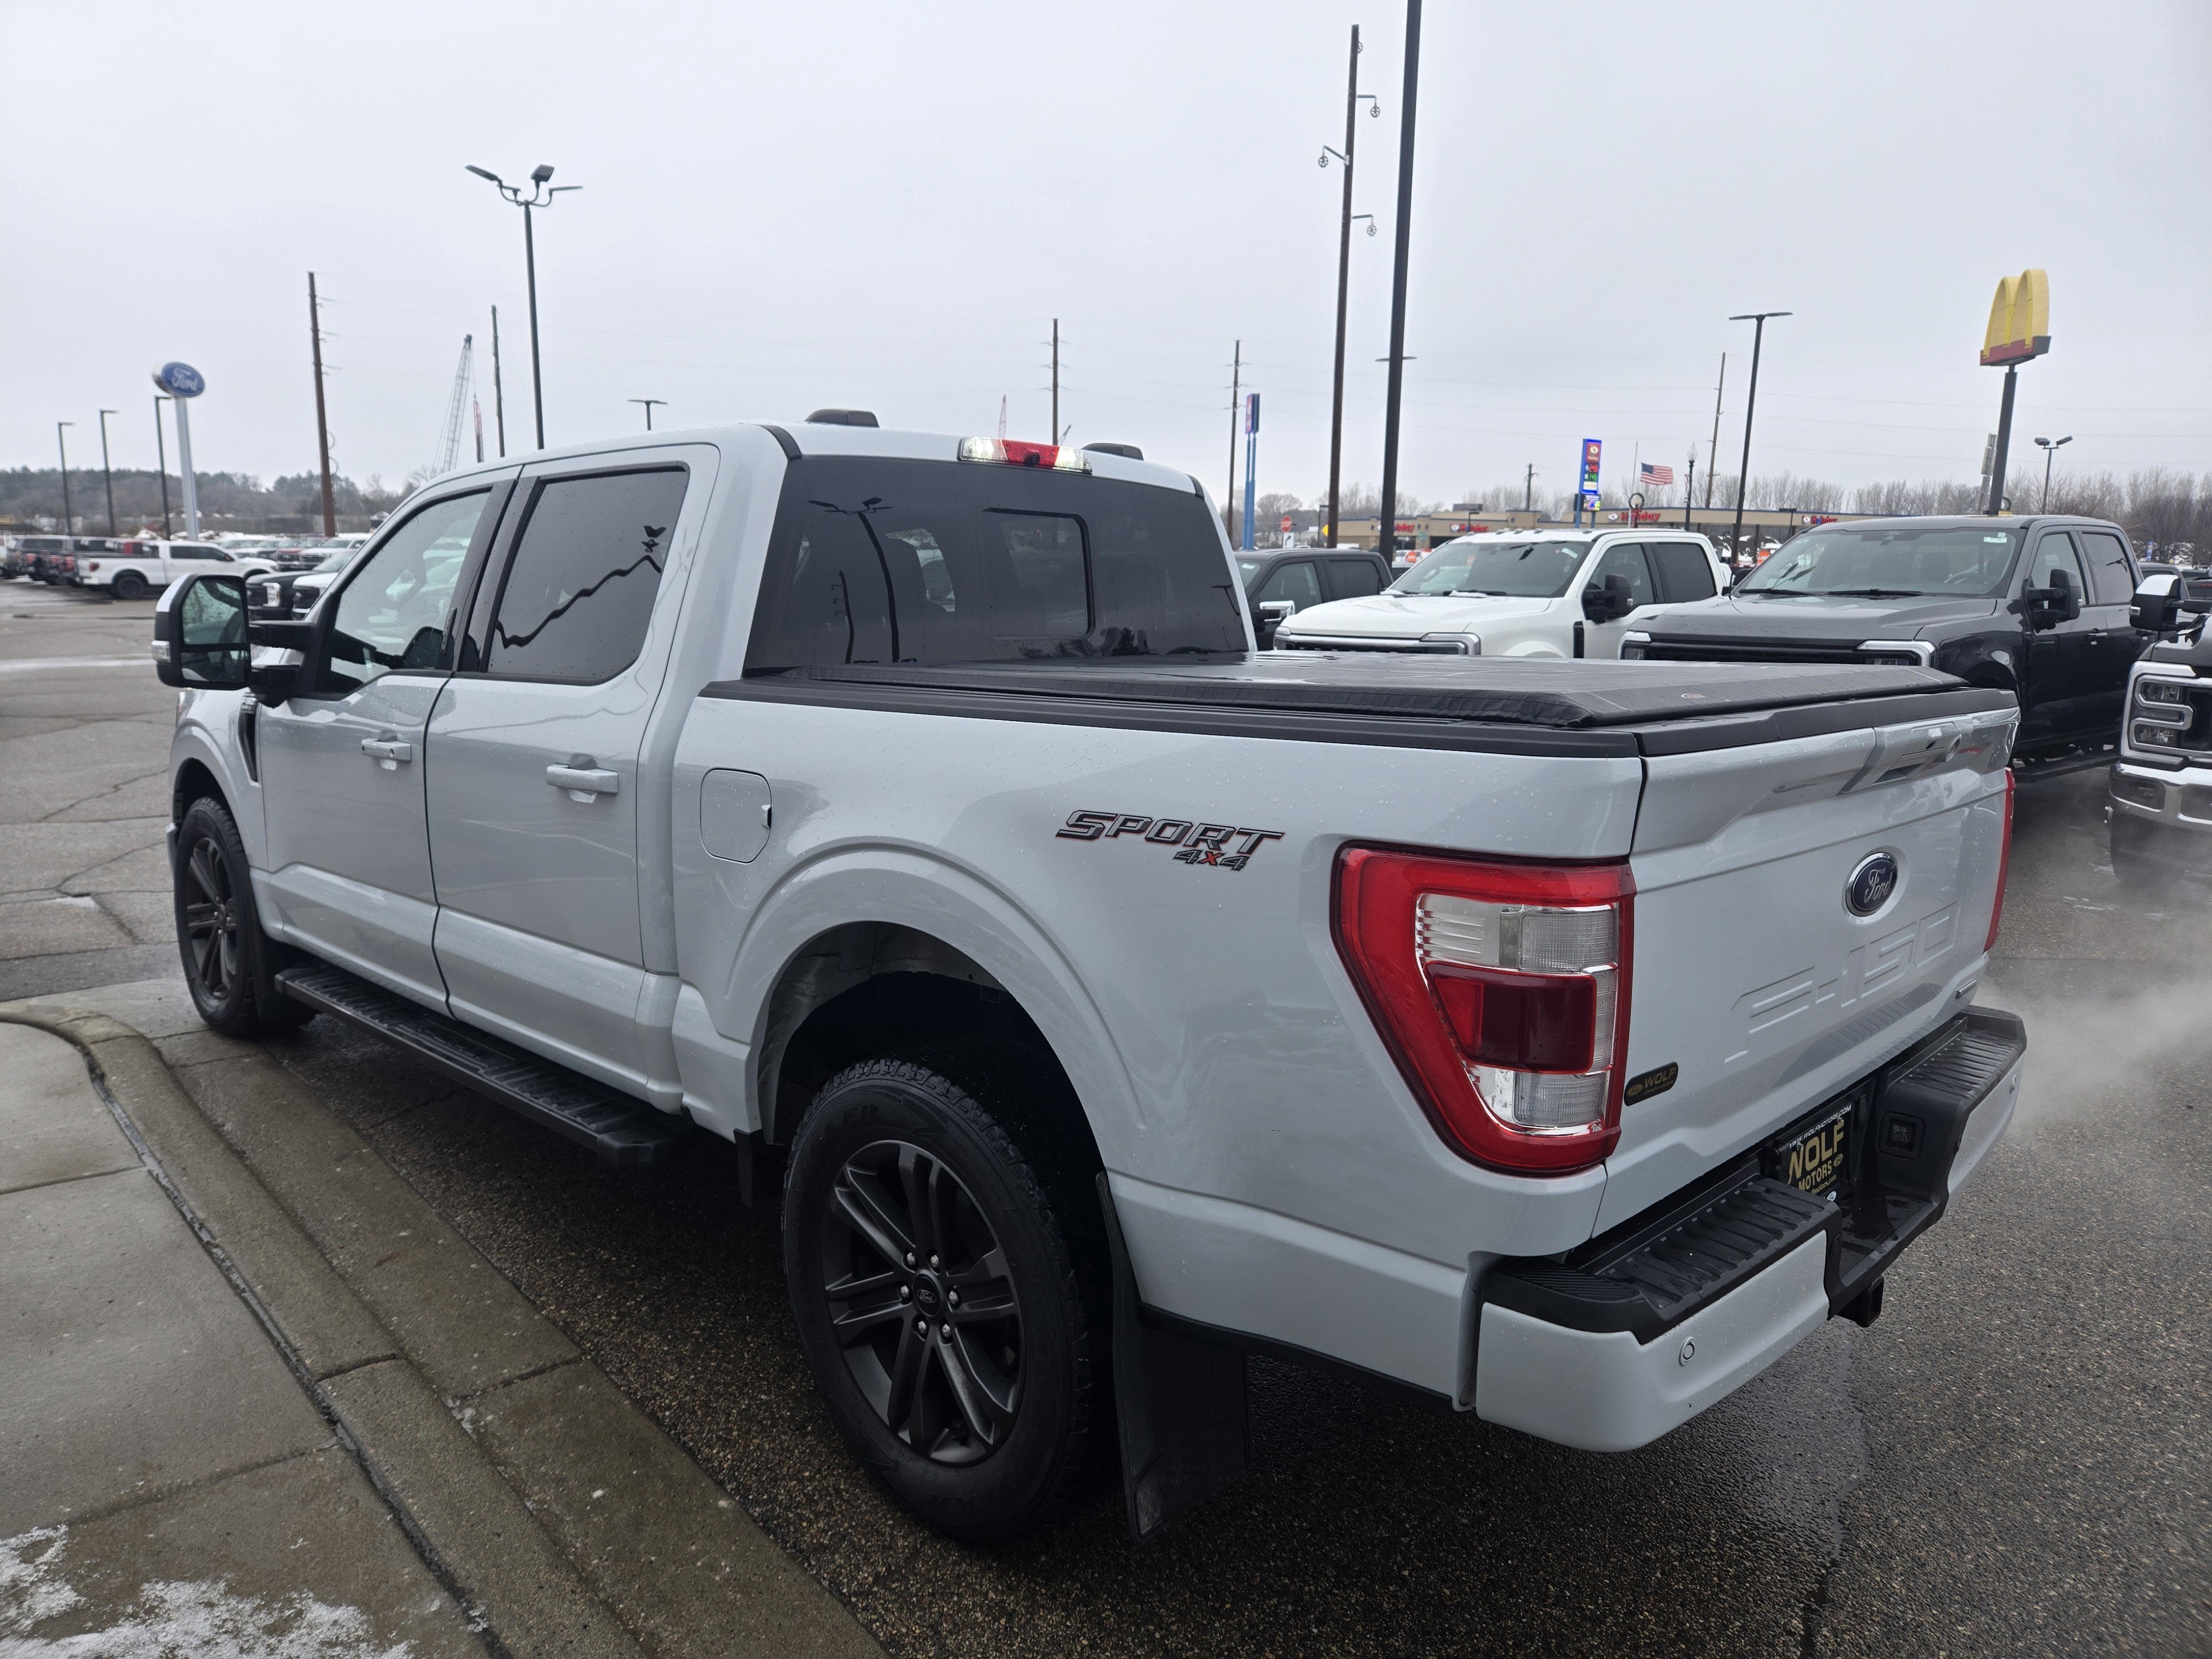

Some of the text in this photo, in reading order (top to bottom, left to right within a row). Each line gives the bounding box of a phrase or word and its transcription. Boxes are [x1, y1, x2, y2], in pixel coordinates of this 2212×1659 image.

[1056, 810, 1285, 856] SPORT
[1864, 867, 1893, 904] Ford
[1724, 901, 1961, 1063] F-150
[1645, 1067, 1677, 1089] WOLF
[1798, 1160, 1832, 1192] MOTORS
[920, 1291, 933, 1302] Ford
